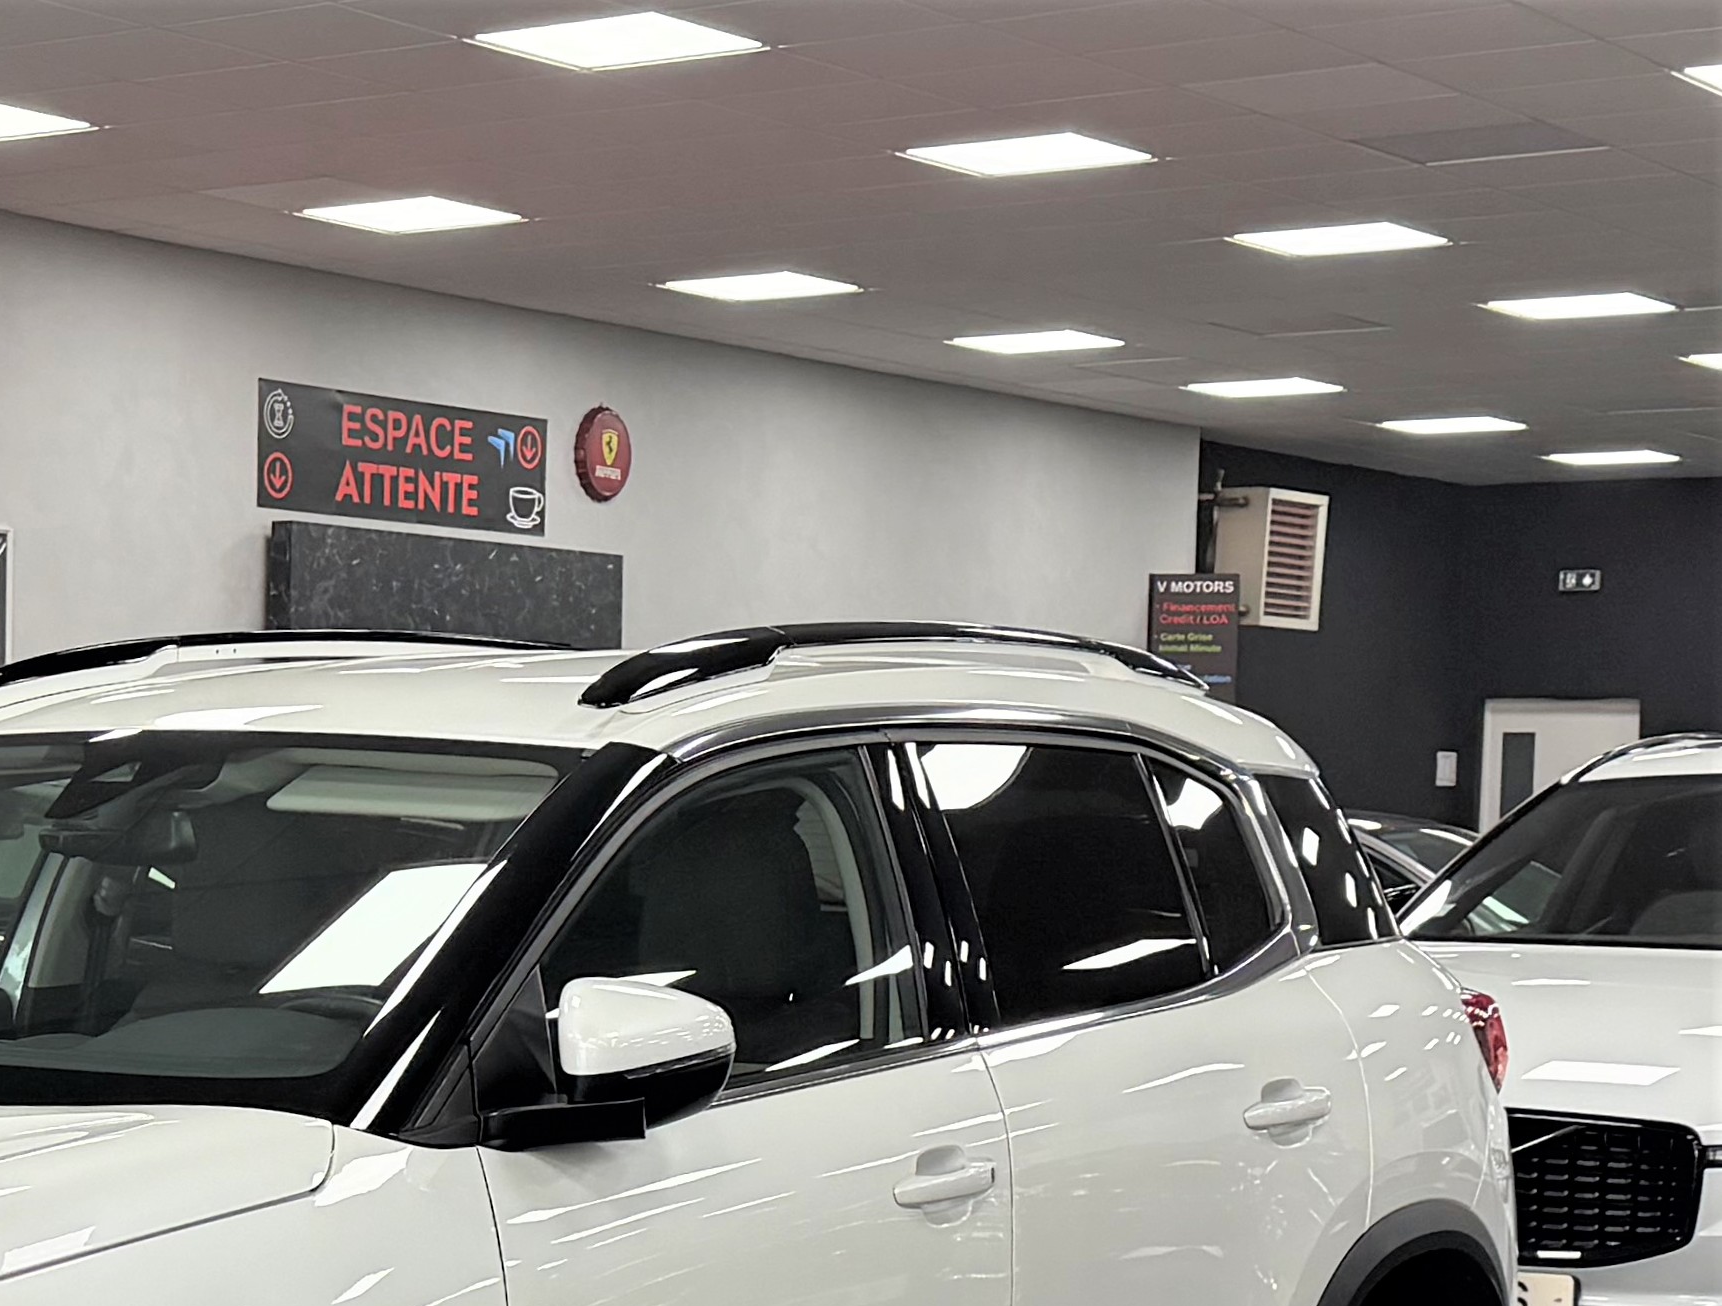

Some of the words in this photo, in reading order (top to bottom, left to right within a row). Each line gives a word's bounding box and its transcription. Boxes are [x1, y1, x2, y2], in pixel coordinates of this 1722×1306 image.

[341, 404, 474, 461] ESPACE
[335, 460, 480, 516] ATTENTE
[1157, 580, 1168, 593] V
[1170, 580, 1235, 593] MOTORS
[1202, 615, 1230, 625] LOA
